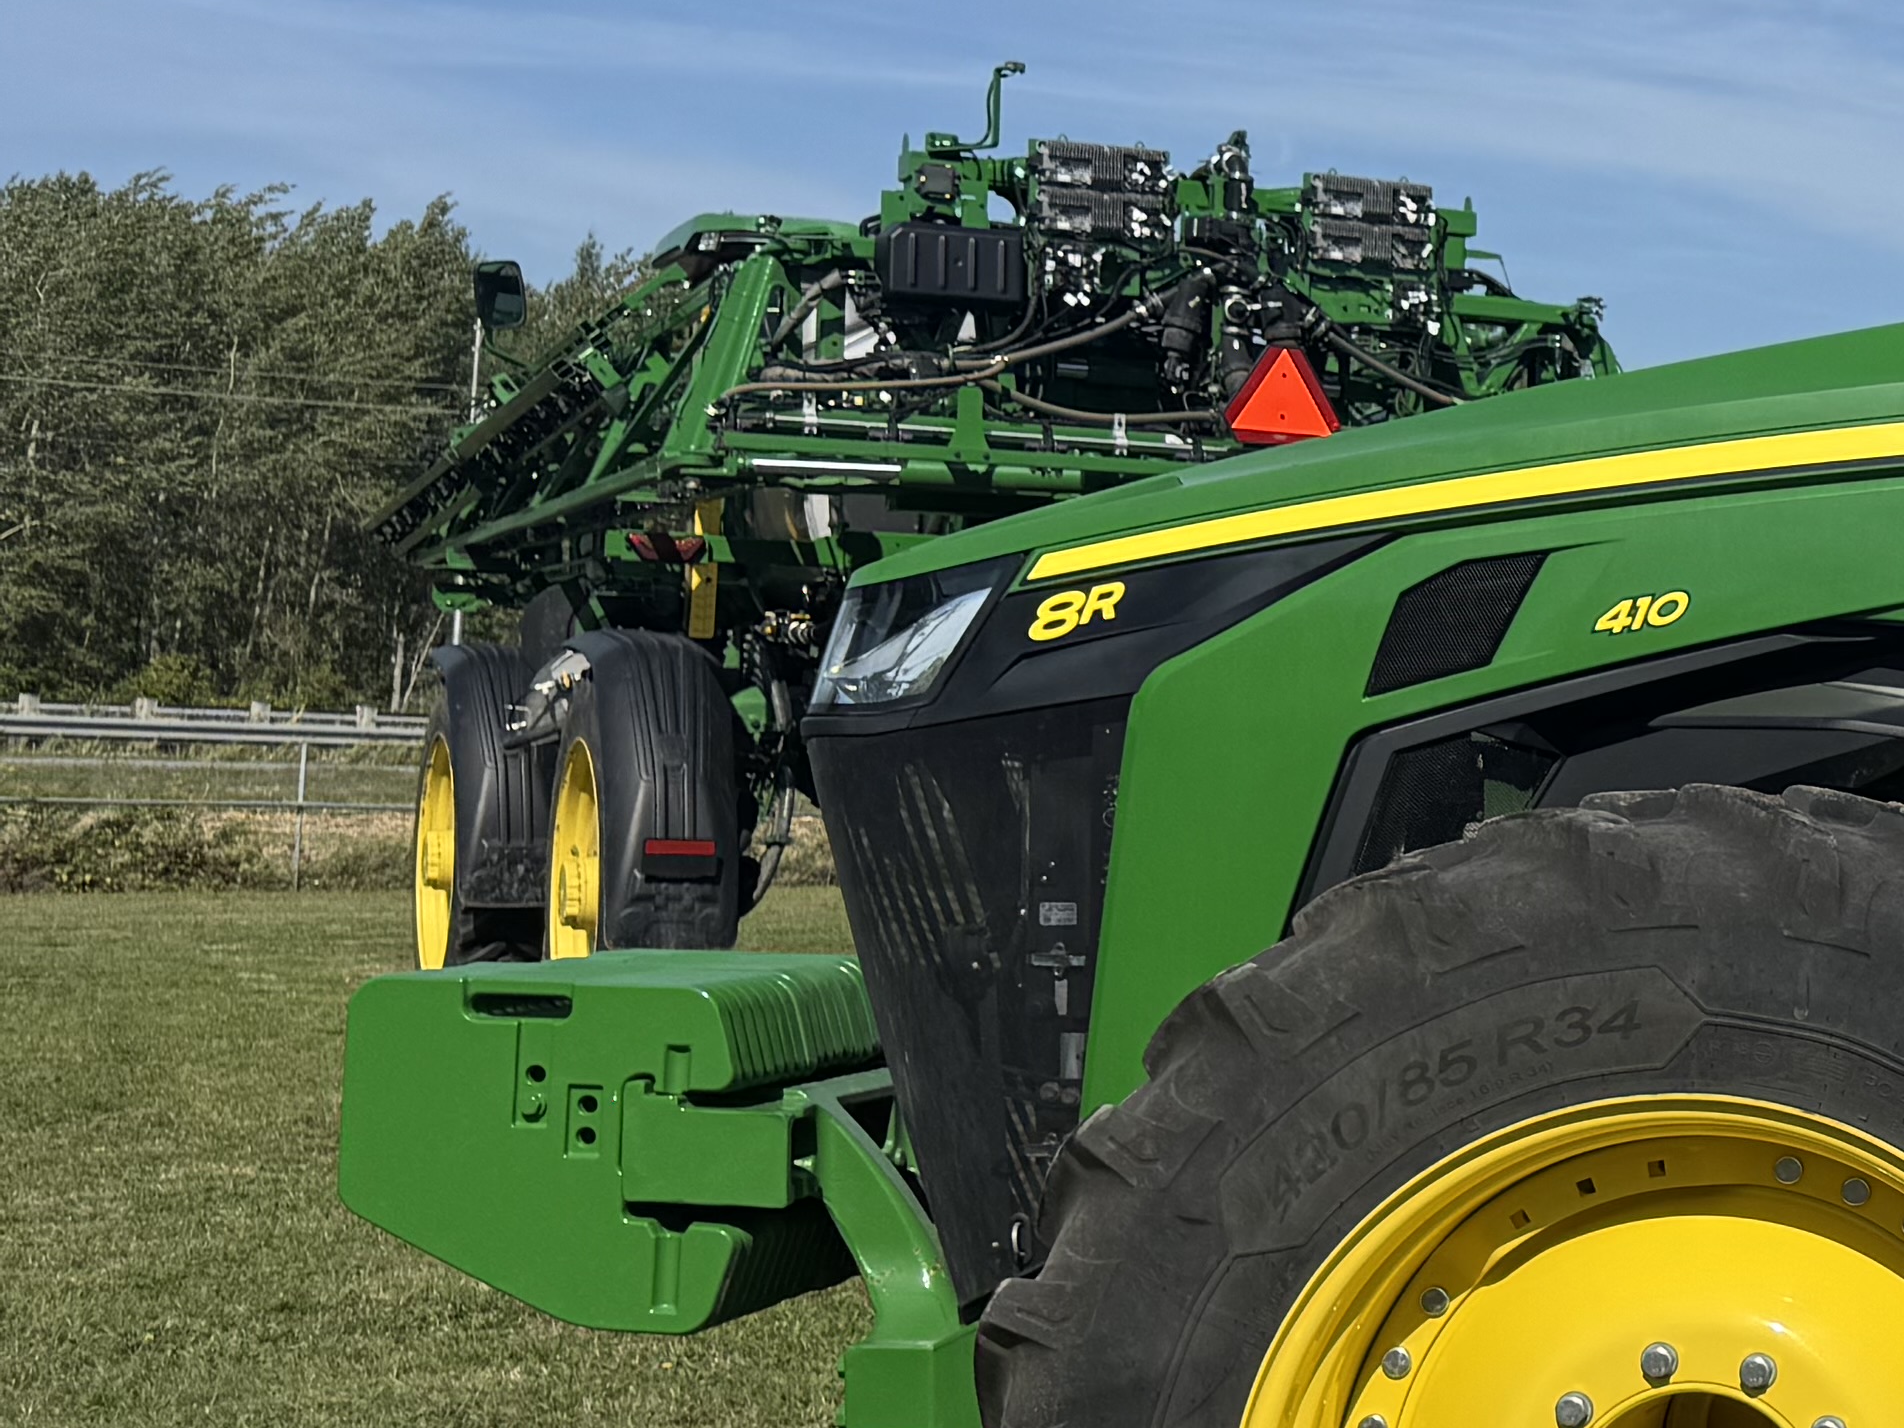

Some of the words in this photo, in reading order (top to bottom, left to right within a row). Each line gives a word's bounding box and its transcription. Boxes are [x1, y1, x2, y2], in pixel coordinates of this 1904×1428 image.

[1028, 581, 1127, 642] 8R
[1592, 590, 1691, 634] 410
[1495, 999, 1643, 1067] R34
